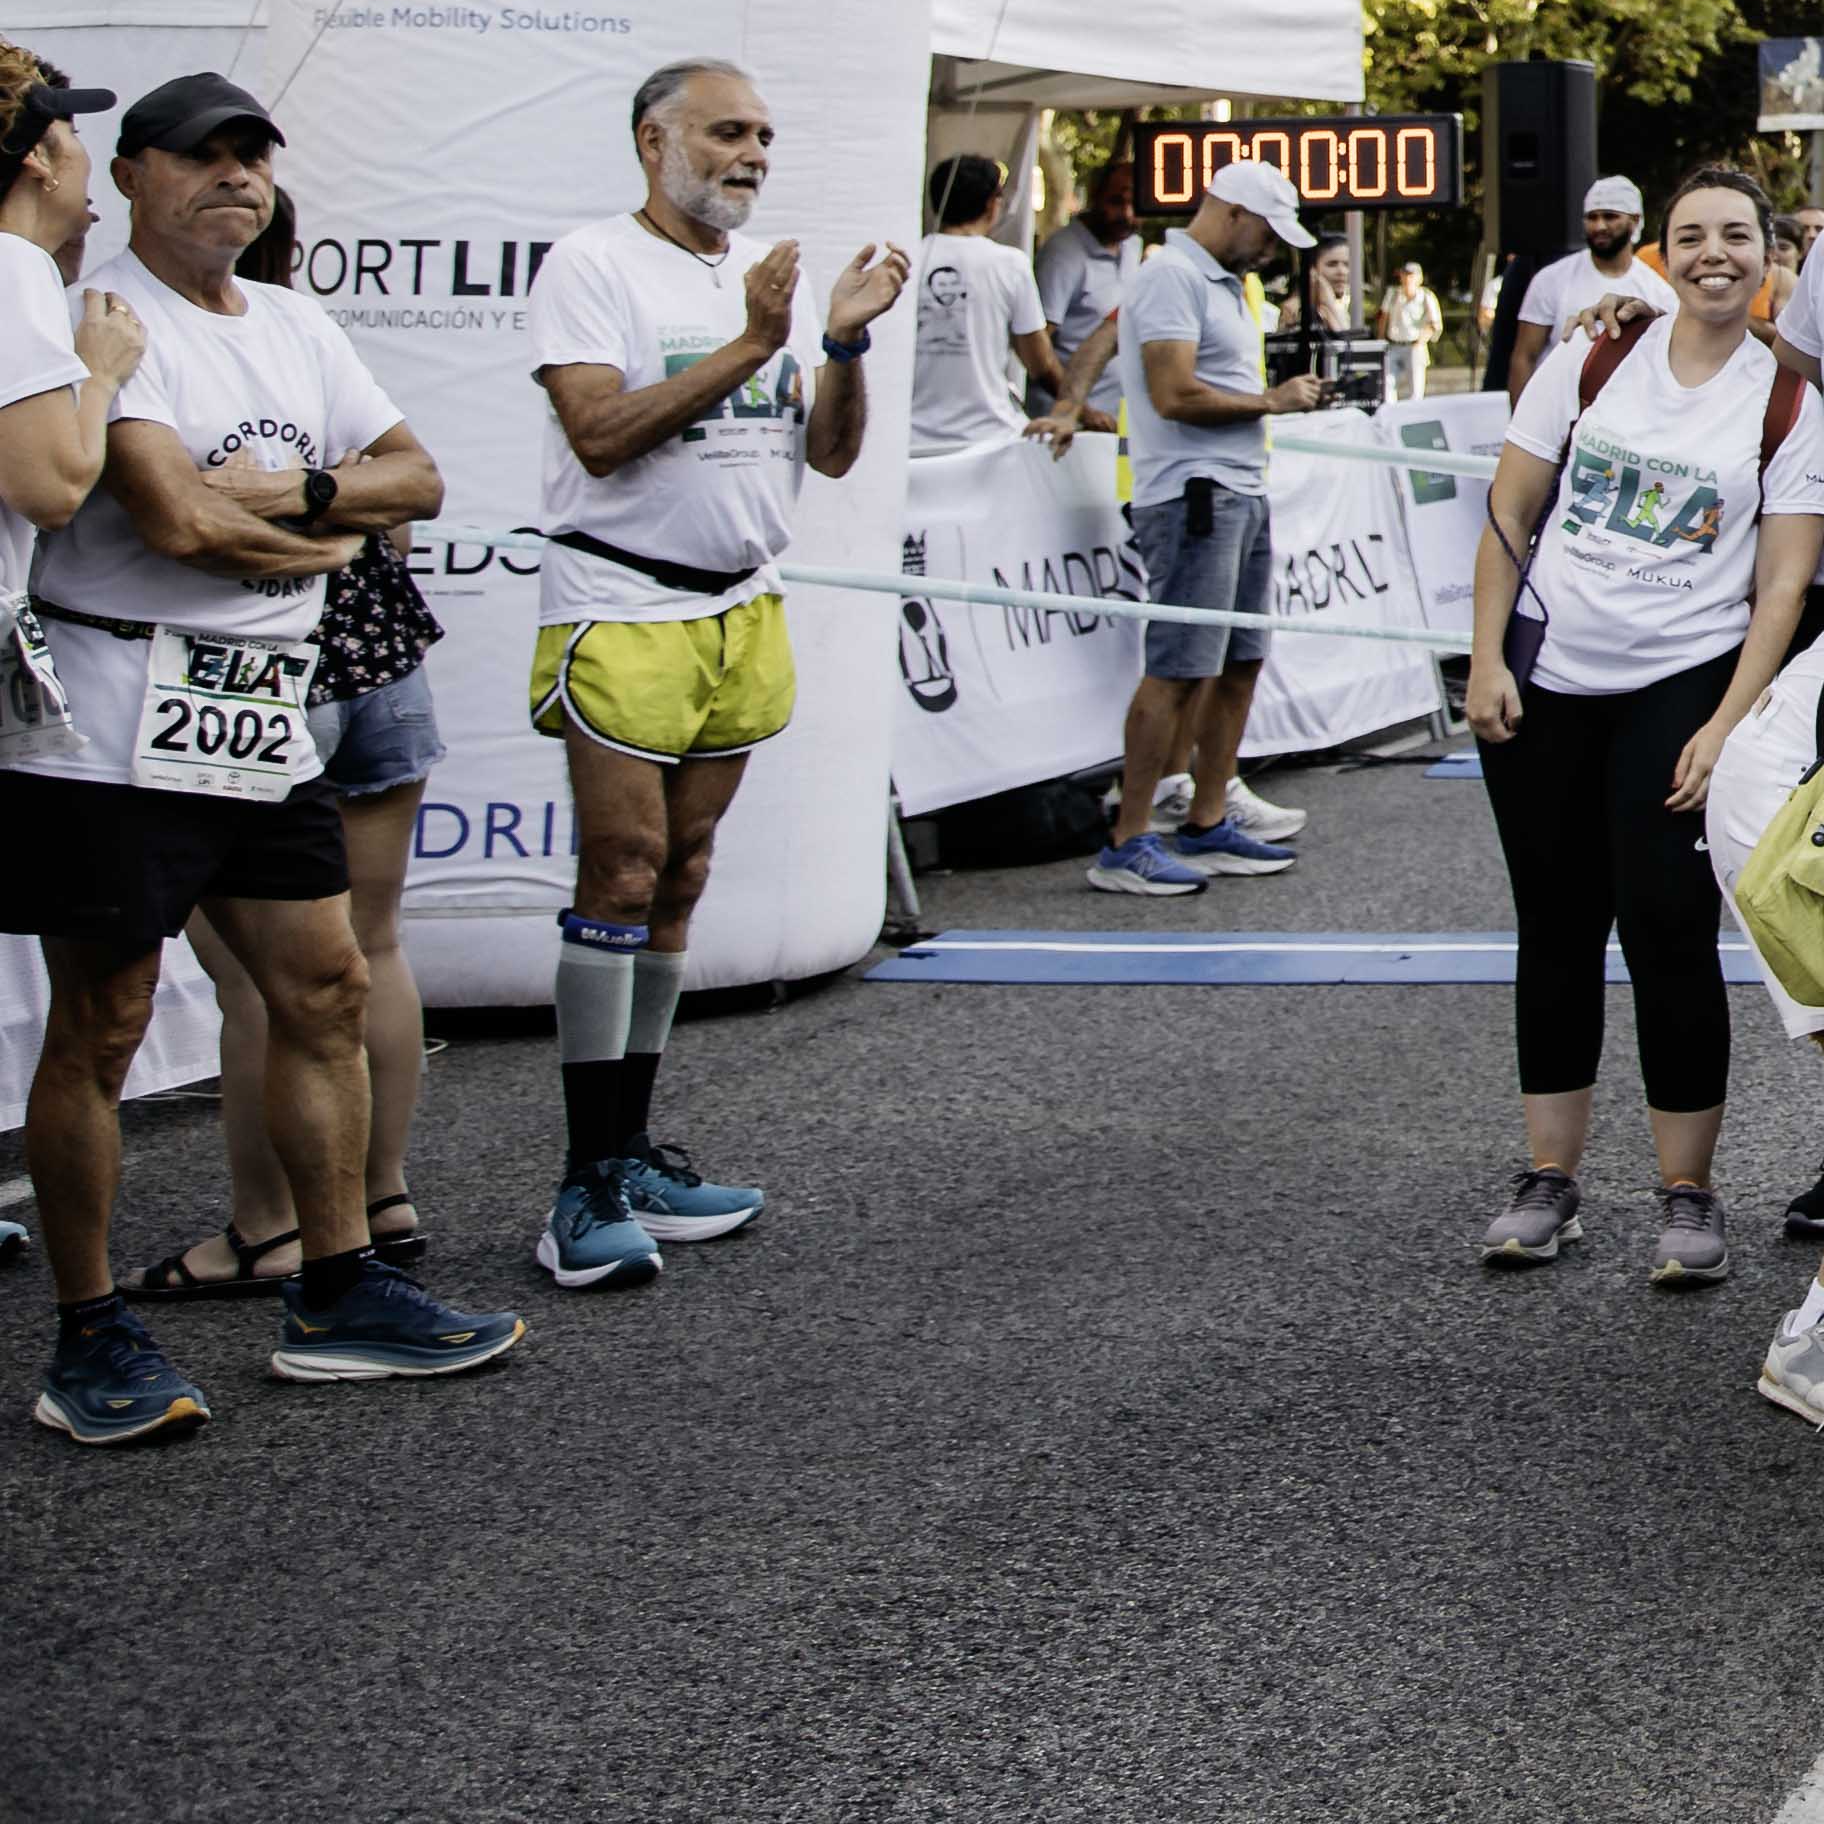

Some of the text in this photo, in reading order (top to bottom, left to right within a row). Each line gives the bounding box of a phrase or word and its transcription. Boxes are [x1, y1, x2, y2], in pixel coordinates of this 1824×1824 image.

[391, 7, 492, 35] Mobility
[499, 9, 631, 34] Solutions
[491, 311, 507, 329] Y
[1577, 430, 1641, 466] MADRID
[1646, 457, 1689, 478] CON
[1693, 466, 1719, 485] LA
[1626, 567, 1694, 591] MUKUA
[150, 697, 293, 766] 2002
